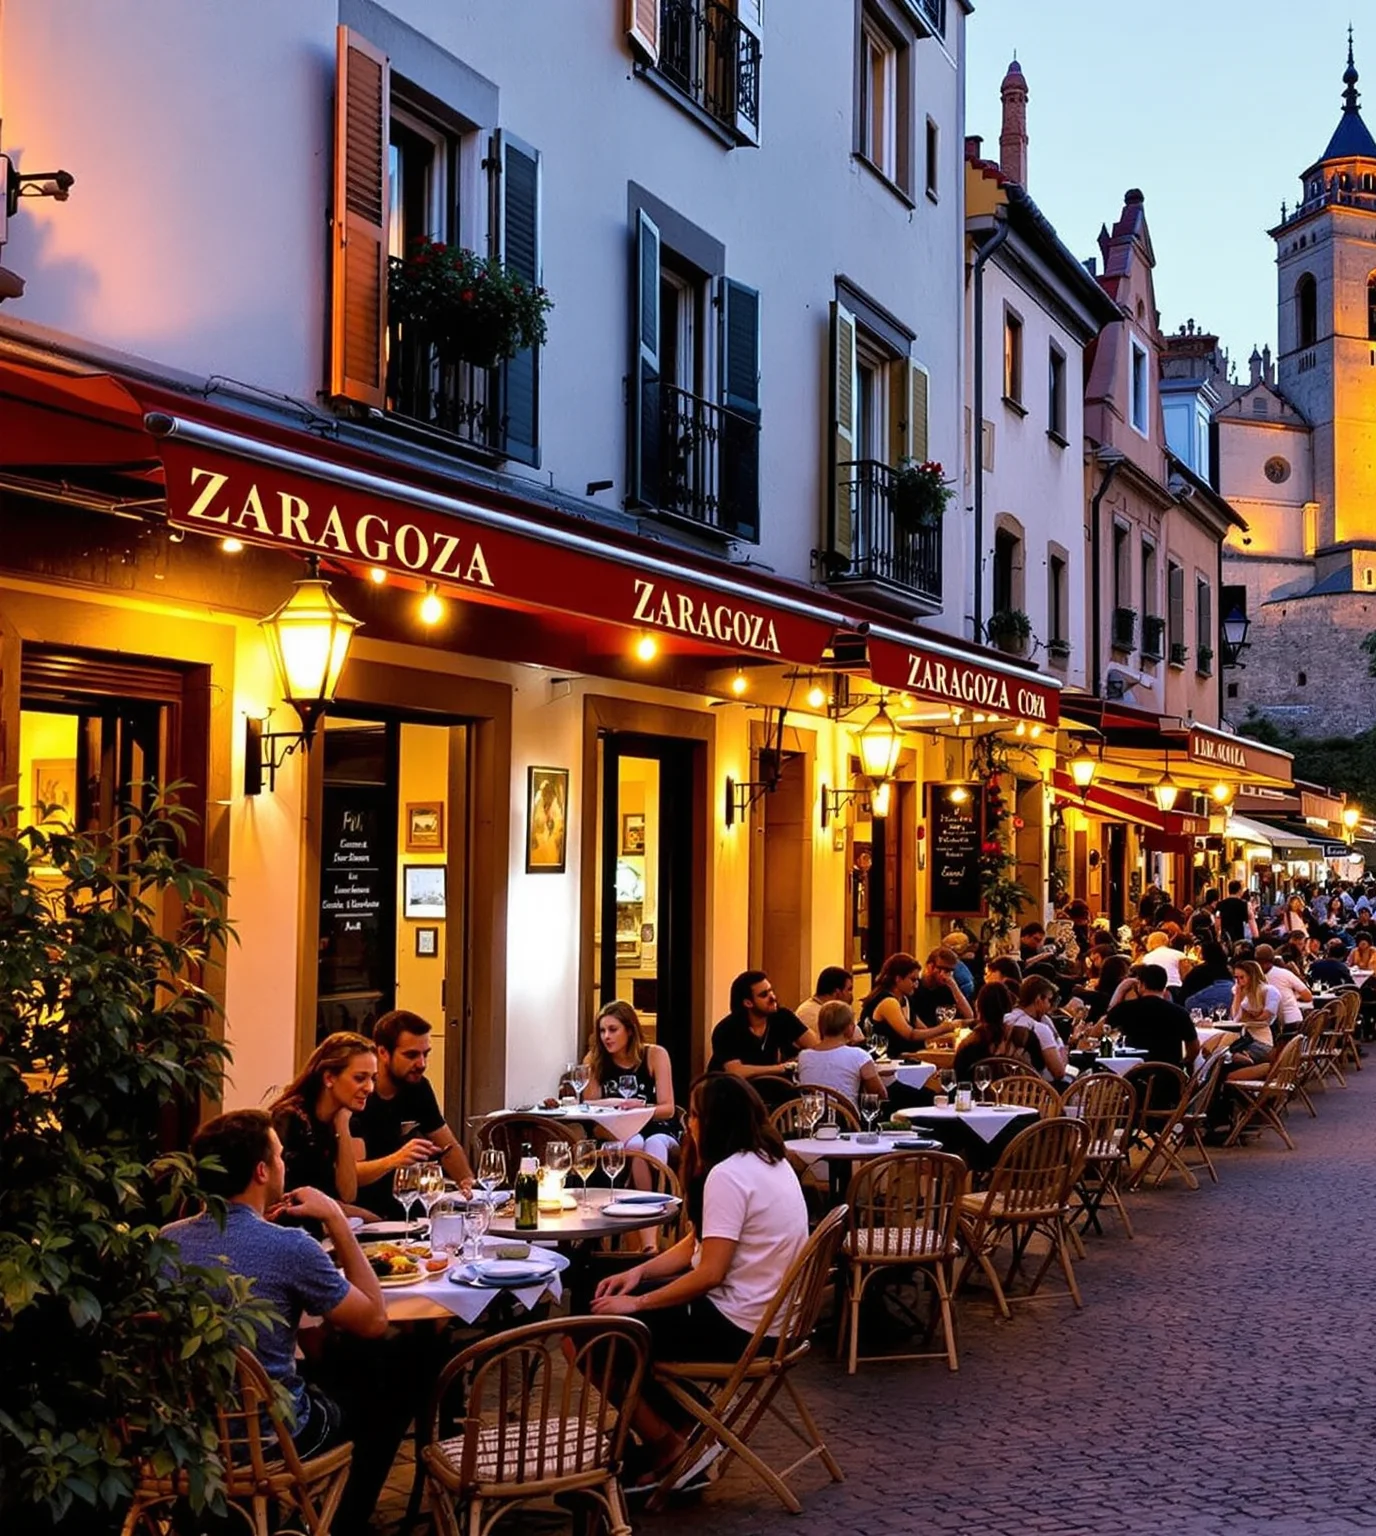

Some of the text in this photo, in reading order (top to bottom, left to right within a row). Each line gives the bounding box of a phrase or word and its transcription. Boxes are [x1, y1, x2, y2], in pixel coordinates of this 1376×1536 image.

[187, 467, 495, 587] ZARAGOZA
[632, 578, 781, 654] ZARAGOZA
[907, 653, 1011, 710] ZARAGOZA
